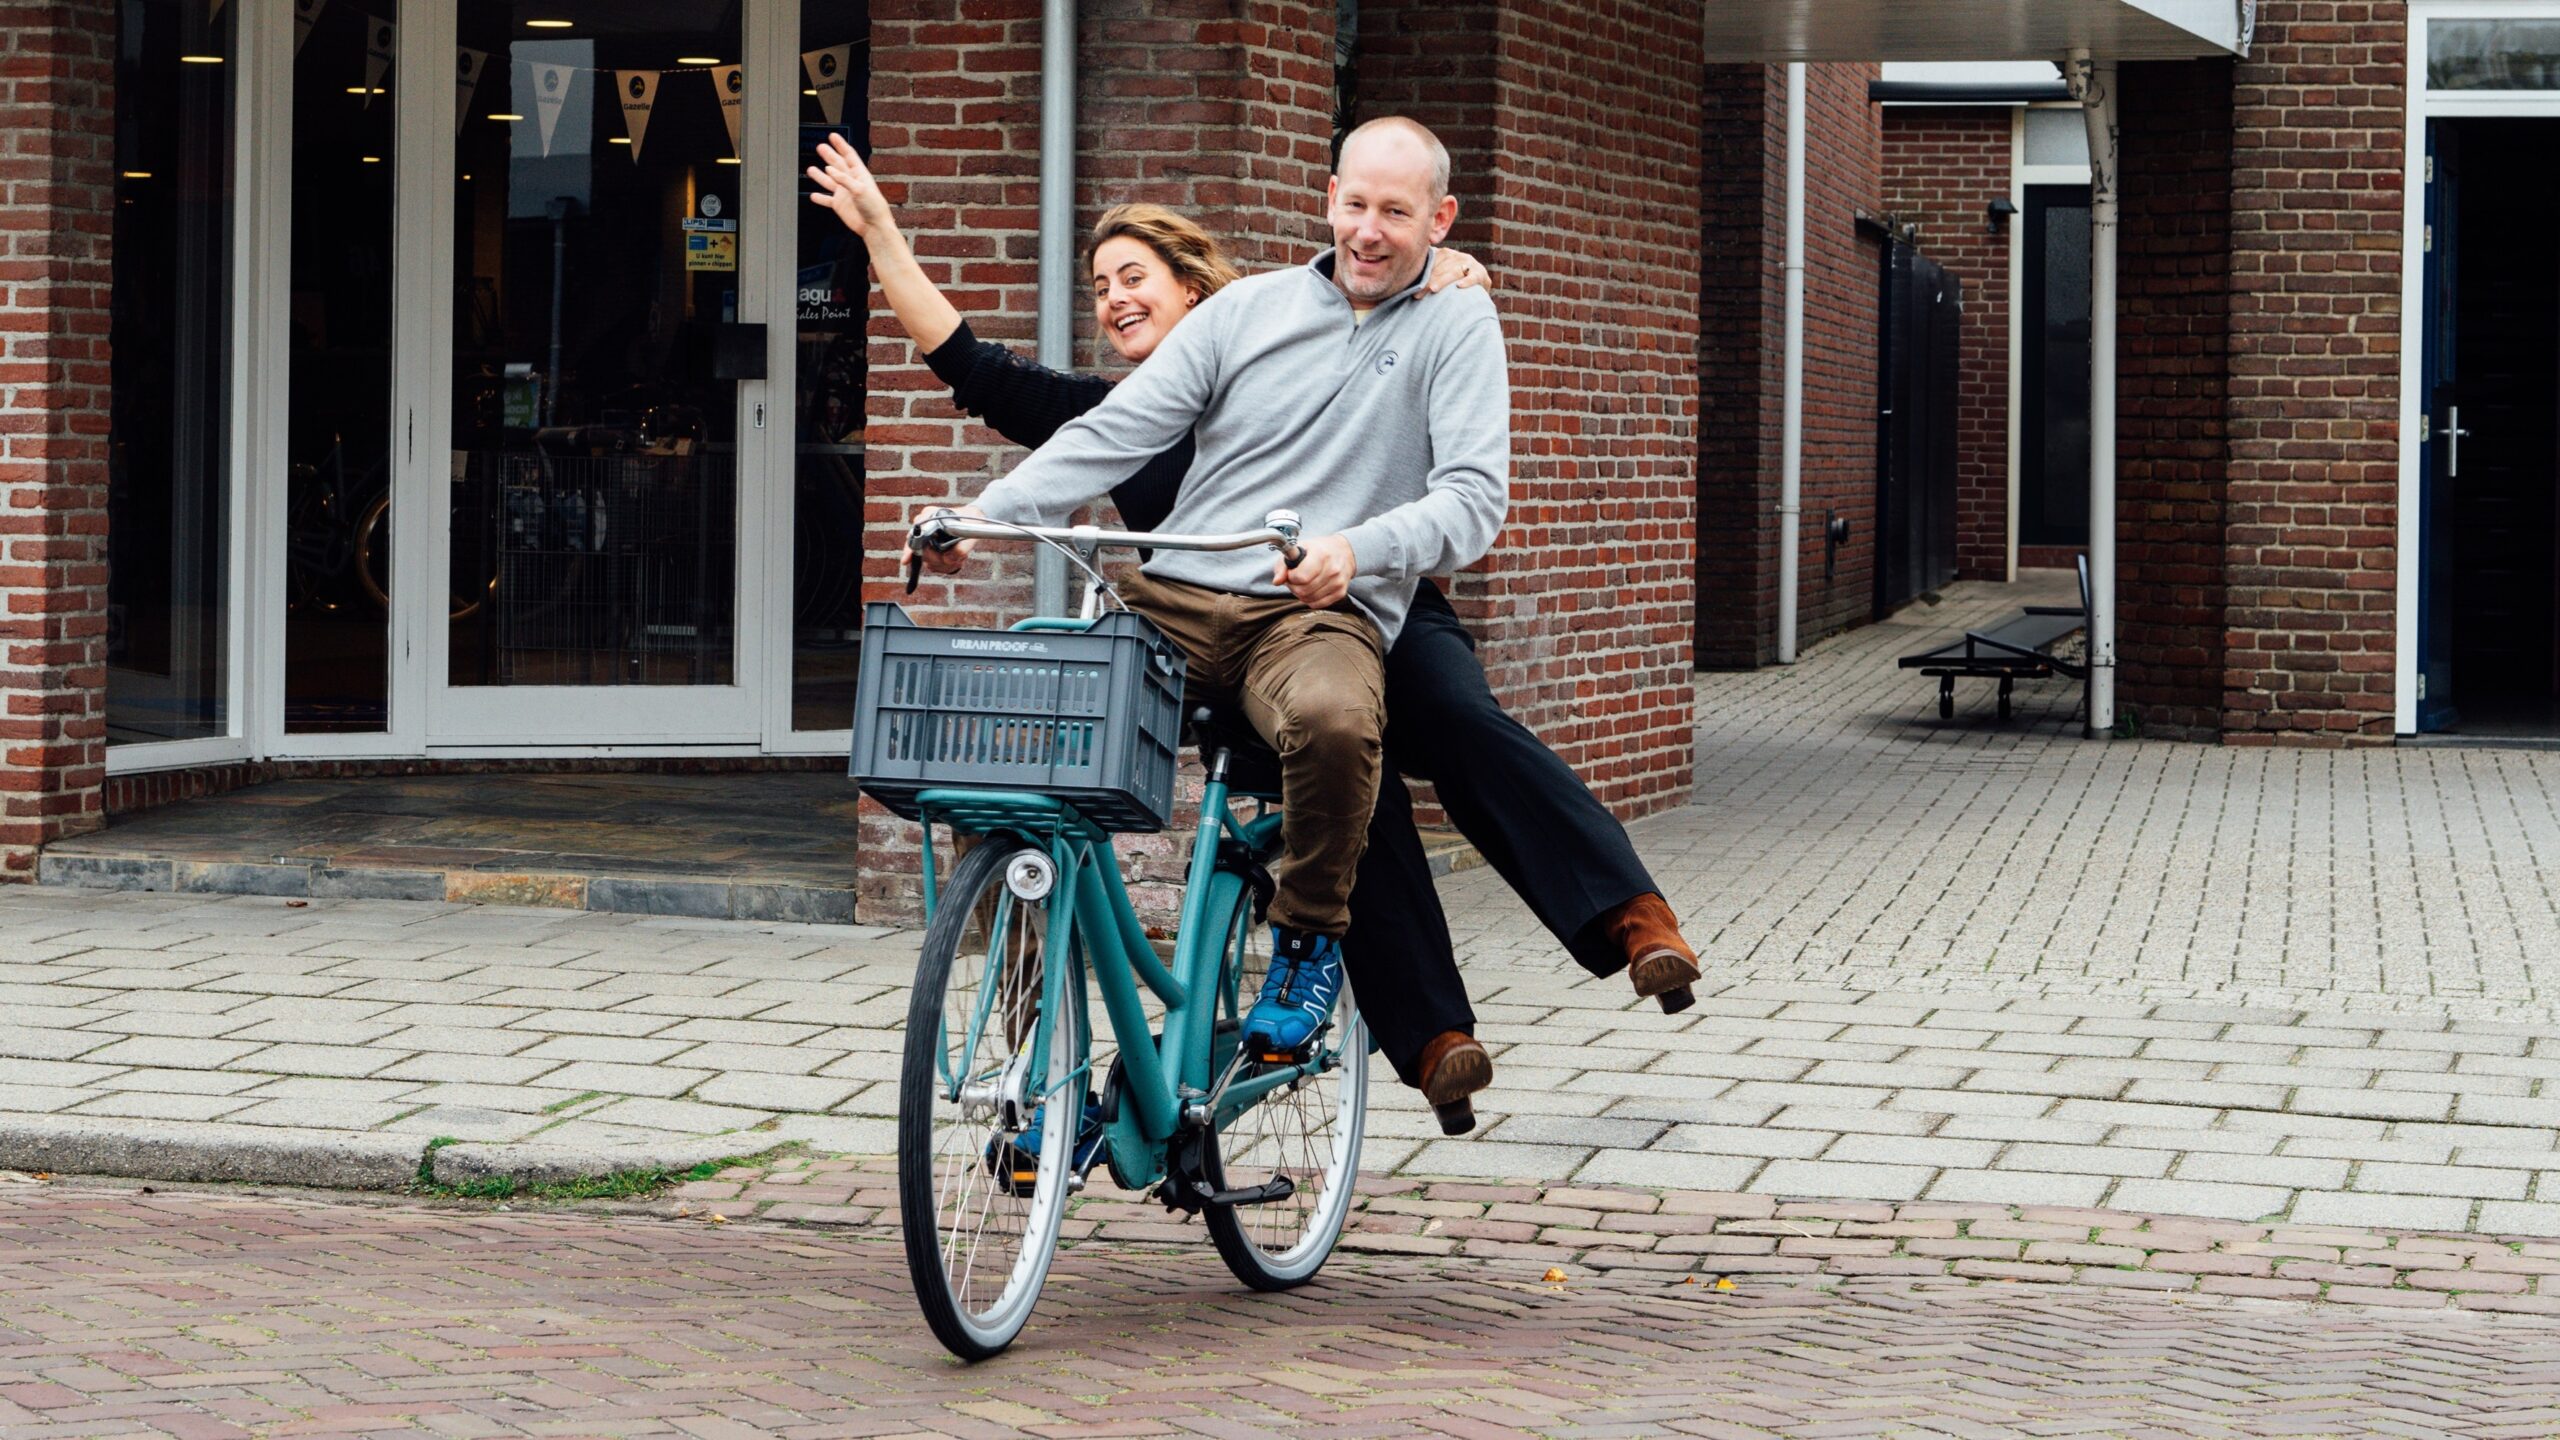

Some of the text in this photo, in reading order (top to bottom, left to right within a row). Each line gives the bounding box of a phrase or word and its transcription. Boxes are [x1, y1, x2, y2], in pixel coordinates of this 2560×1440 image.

[815, 79, 846, 90] Gazelle
[623, 102, 650, 111] Gazelle
[799, 288, 831, 305] agu
[822, 306, 851, 320] Point
